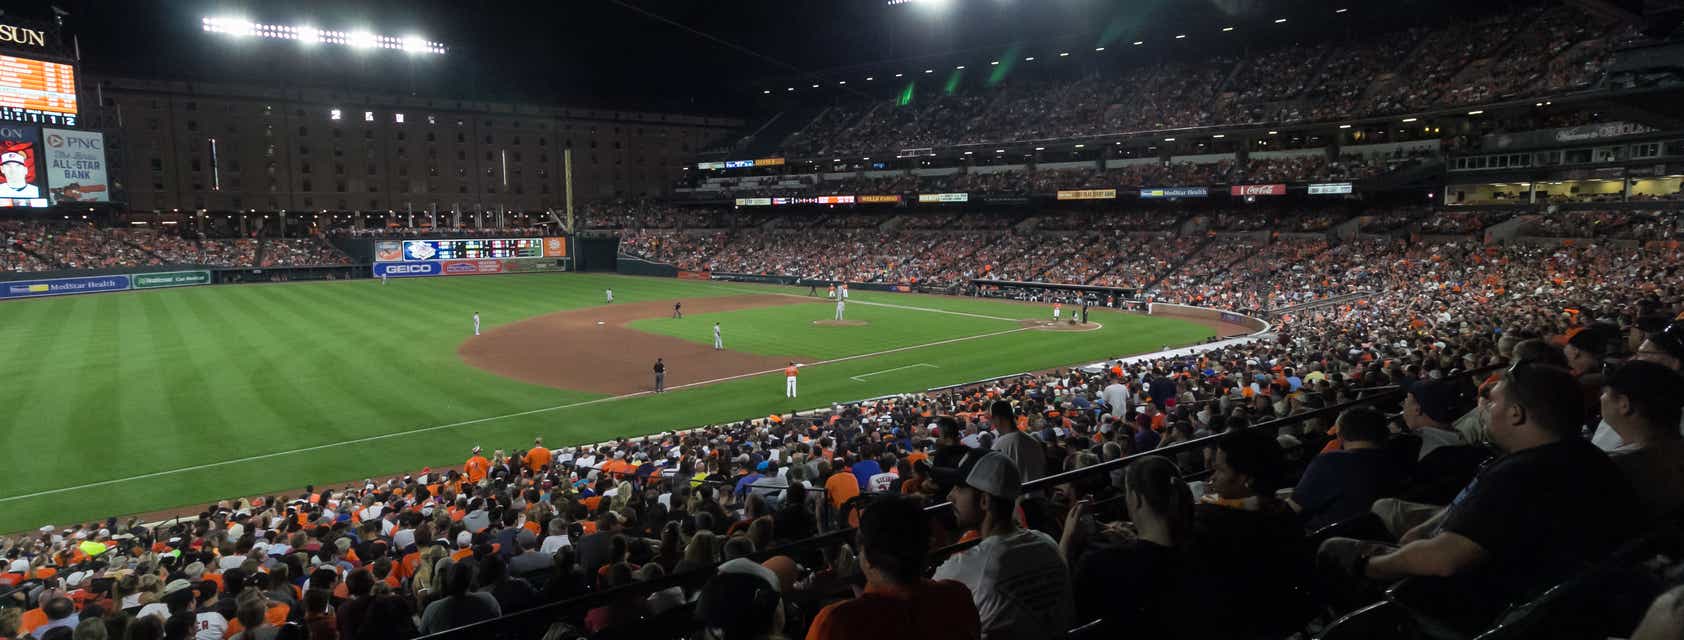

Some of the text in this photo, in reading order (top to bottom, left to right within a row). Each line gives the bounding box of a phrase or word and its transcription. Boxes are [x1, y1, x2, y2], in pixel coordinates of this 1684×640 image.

[0, 24, 45, 47] SUN
[67, 137, 100, 149] PNC
[53, 159, 100, 170] ALL-STAR
[64, 169, 90, 180] BANK
[386, 264, 431, 274] GEICO
[88, 280, 115, 288] Health
